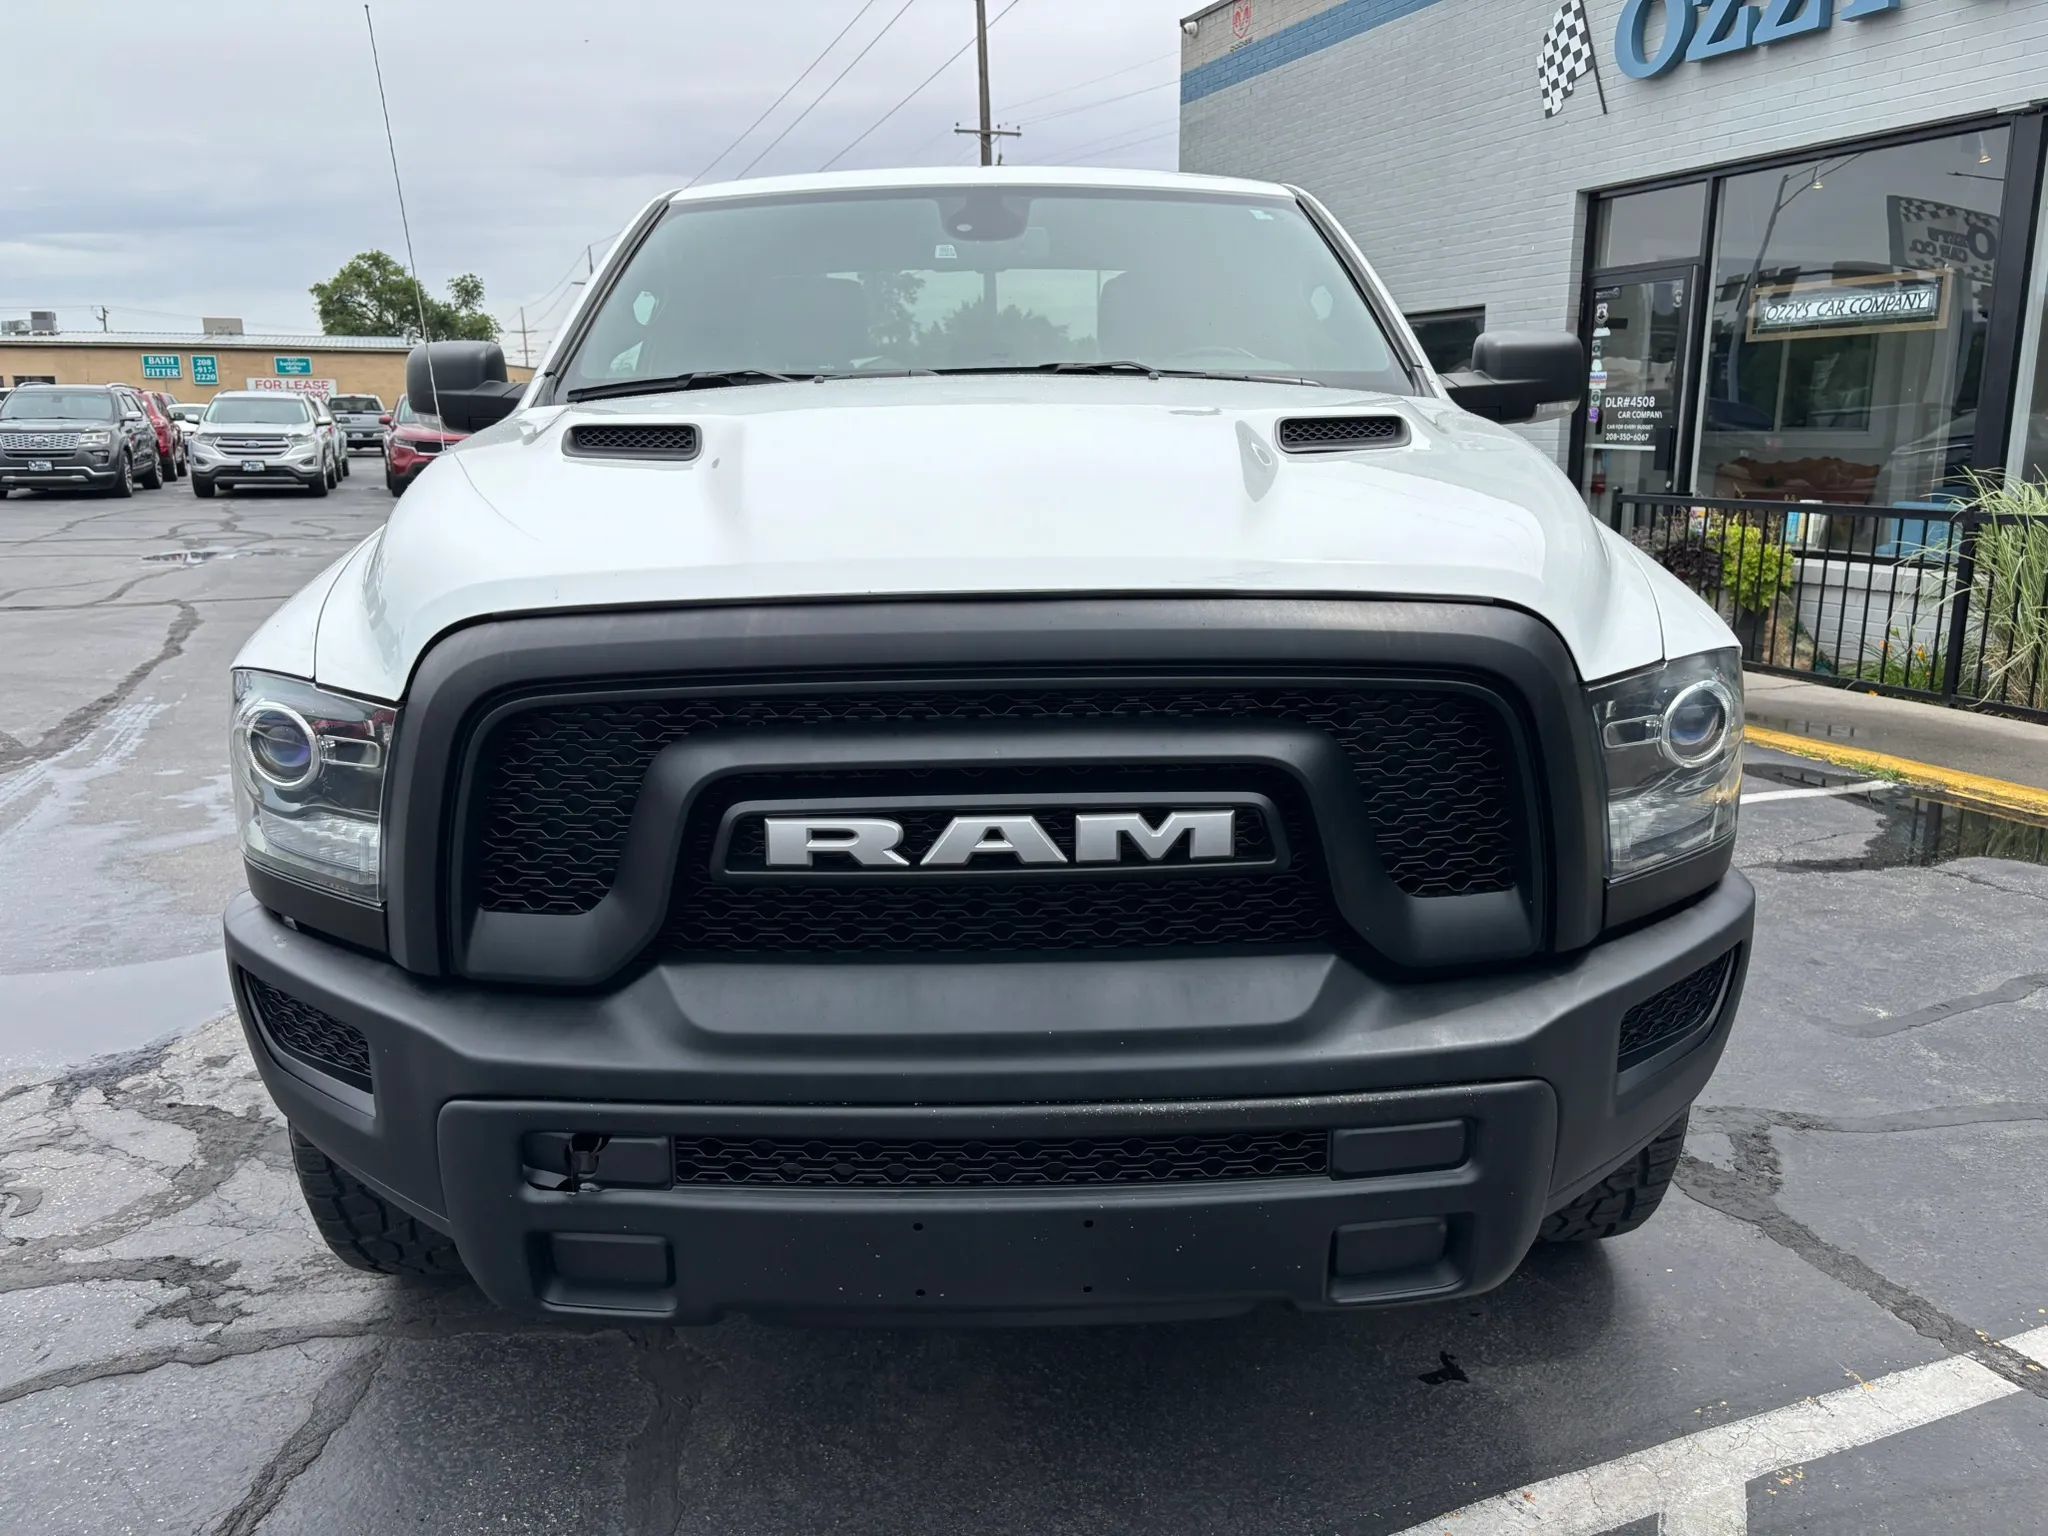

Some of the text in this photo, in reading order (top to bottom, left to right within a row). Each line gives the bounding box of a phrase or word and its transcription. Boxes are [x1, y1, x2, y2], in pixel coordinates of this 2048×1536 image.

[1765, 292, 1931, 321] OZZY'S CAR COMPANY
[148, 356, 175, 365] BATH
[196, 358, 212, 366] 208
[146, 368, 179, 377] FITTER
[255, 379, 330, 391] FOR LEASE
[1605, 396, 1656, 408] DLR#4508
[1617, 411, 1631, 419] CAR
[764, 808, 1236, 867] RAM
